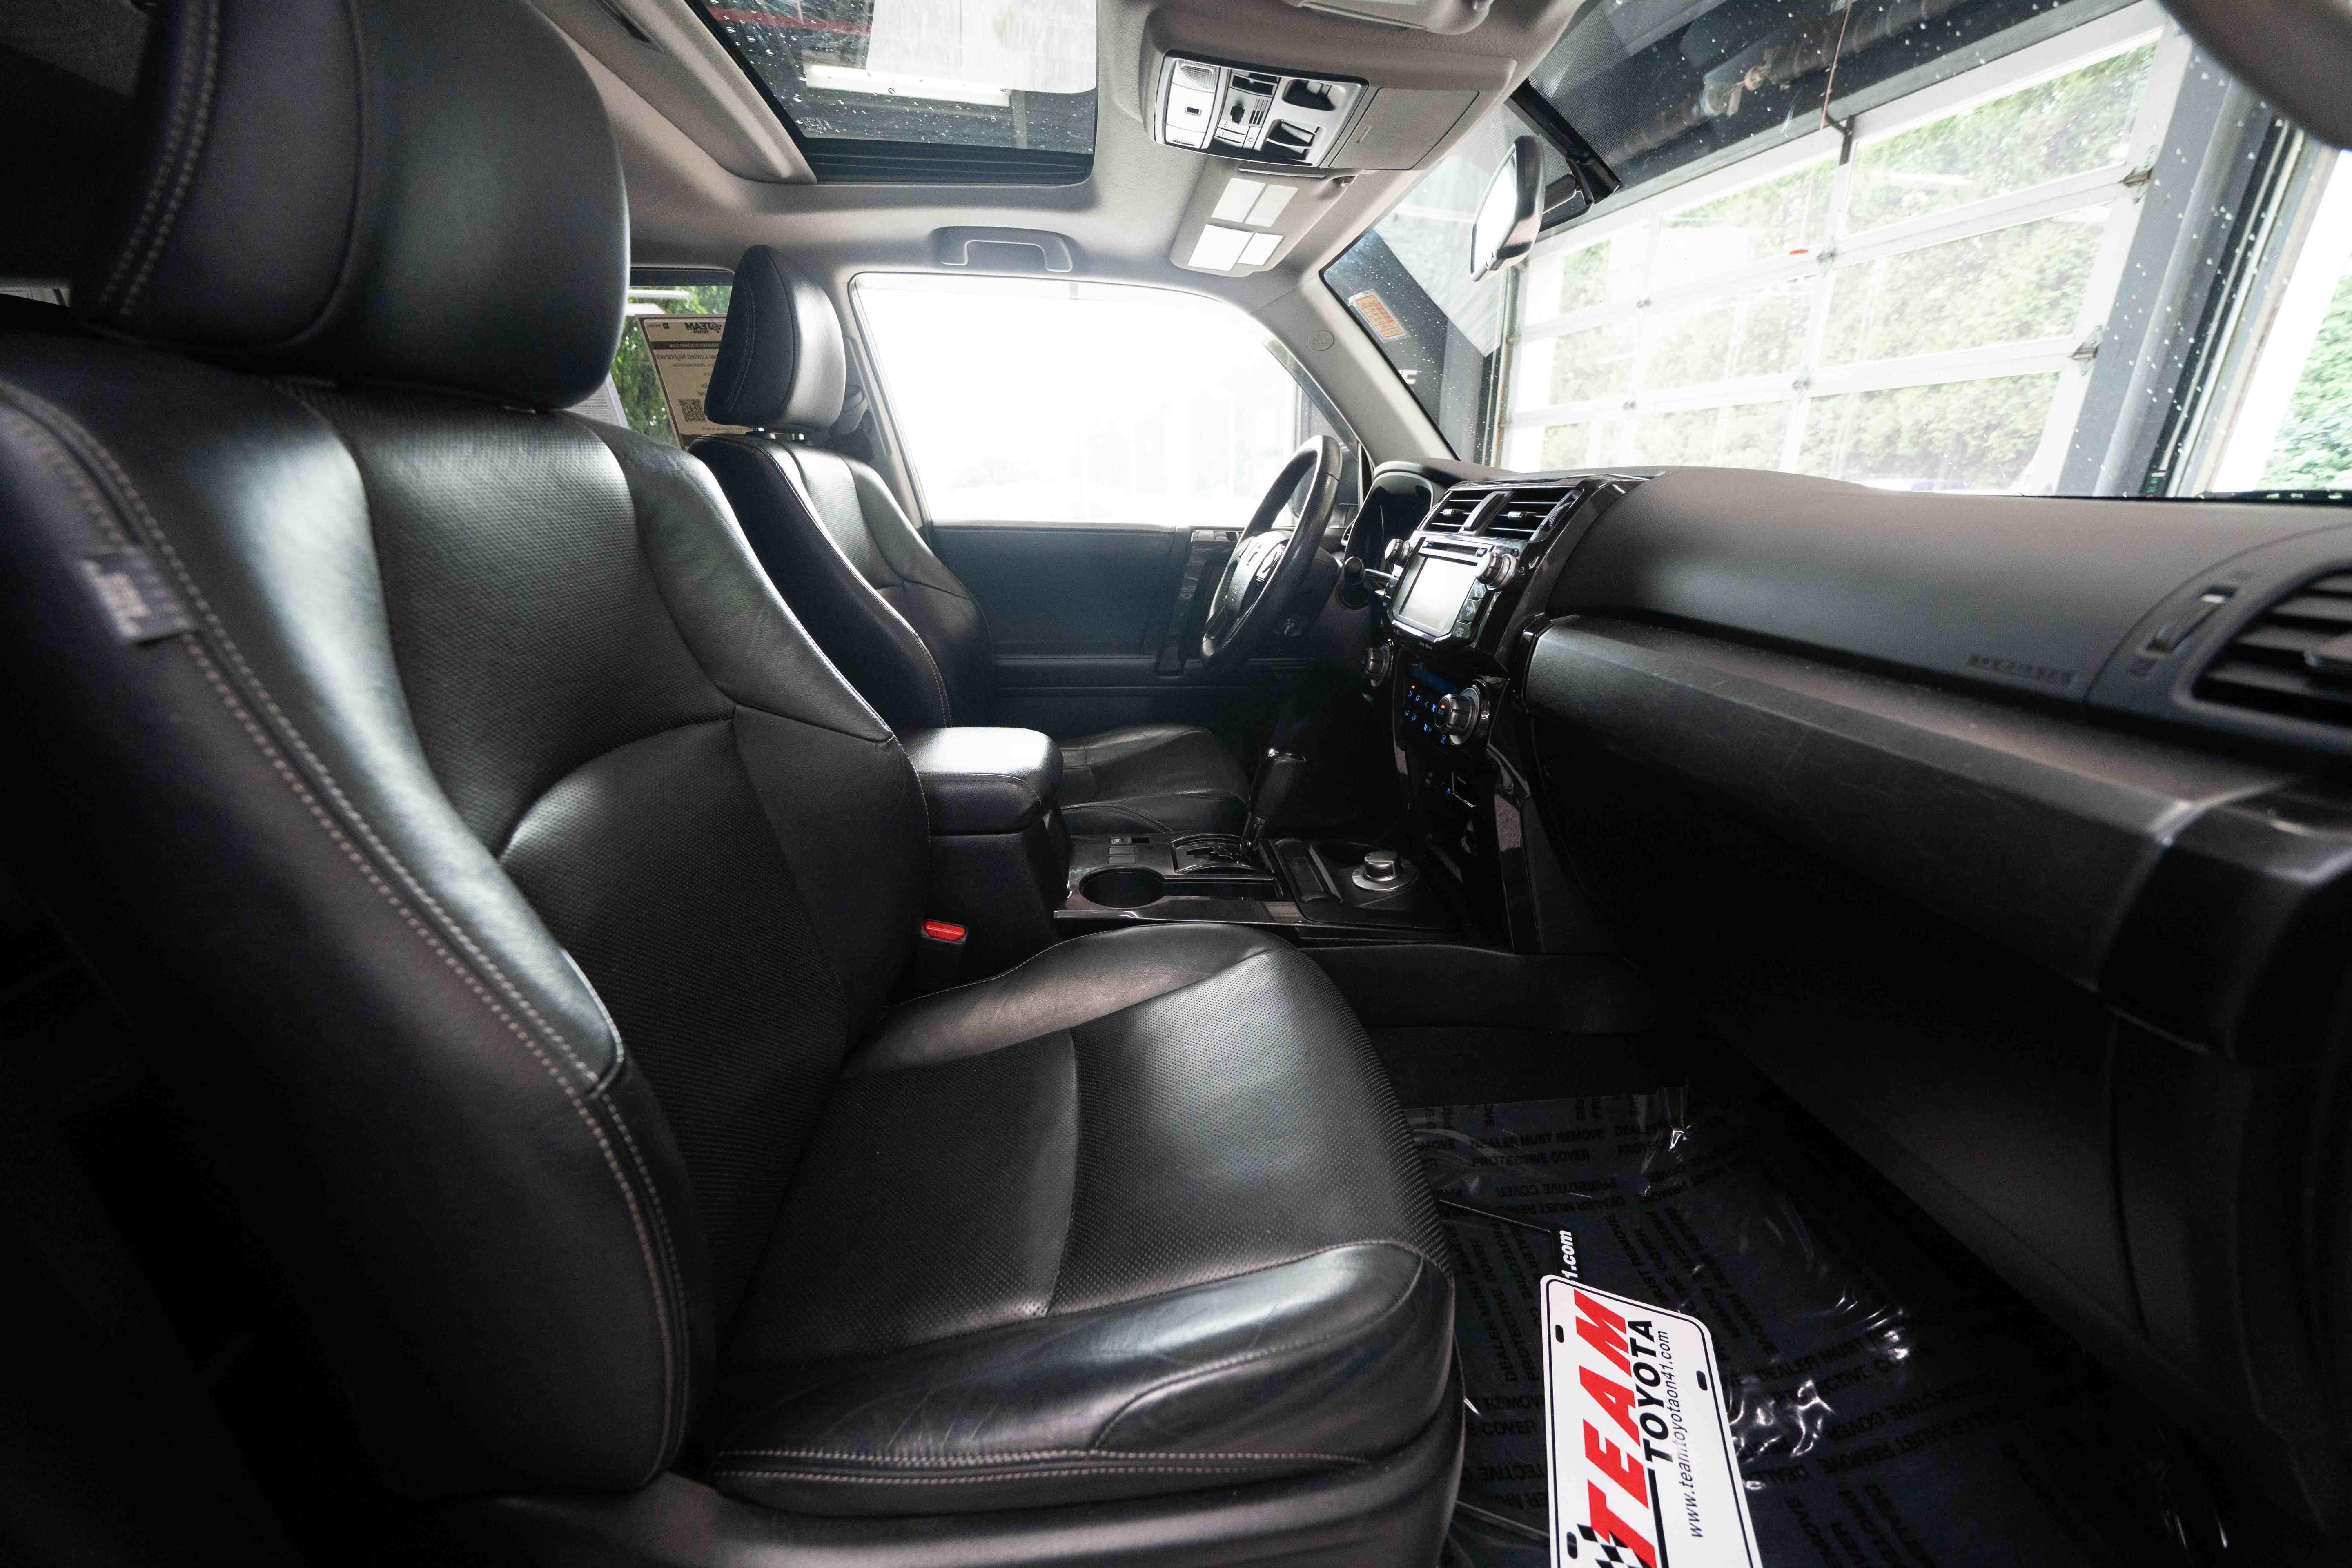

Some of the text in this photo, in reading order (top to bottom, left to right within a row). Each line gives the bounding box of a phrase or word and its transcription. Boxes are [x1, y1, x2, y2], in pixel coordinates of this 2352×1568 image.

[1556, 1128, 1605, 1142] REMOVE
[1551, 1149, 1591, 1164] COVER
[1495, 1185, 1539, 1197] COVER
[1559, 1230, 1578, 1279] 1.com
[1627, 1320, 1673, 1463] TOYOTA
[1482, 1420, 1537, 1437] COVER
[1573, 1288, 1657, 1568] TEAM
[1657, 1330, 1703, 1538] www.teamtoyotaon41.com
